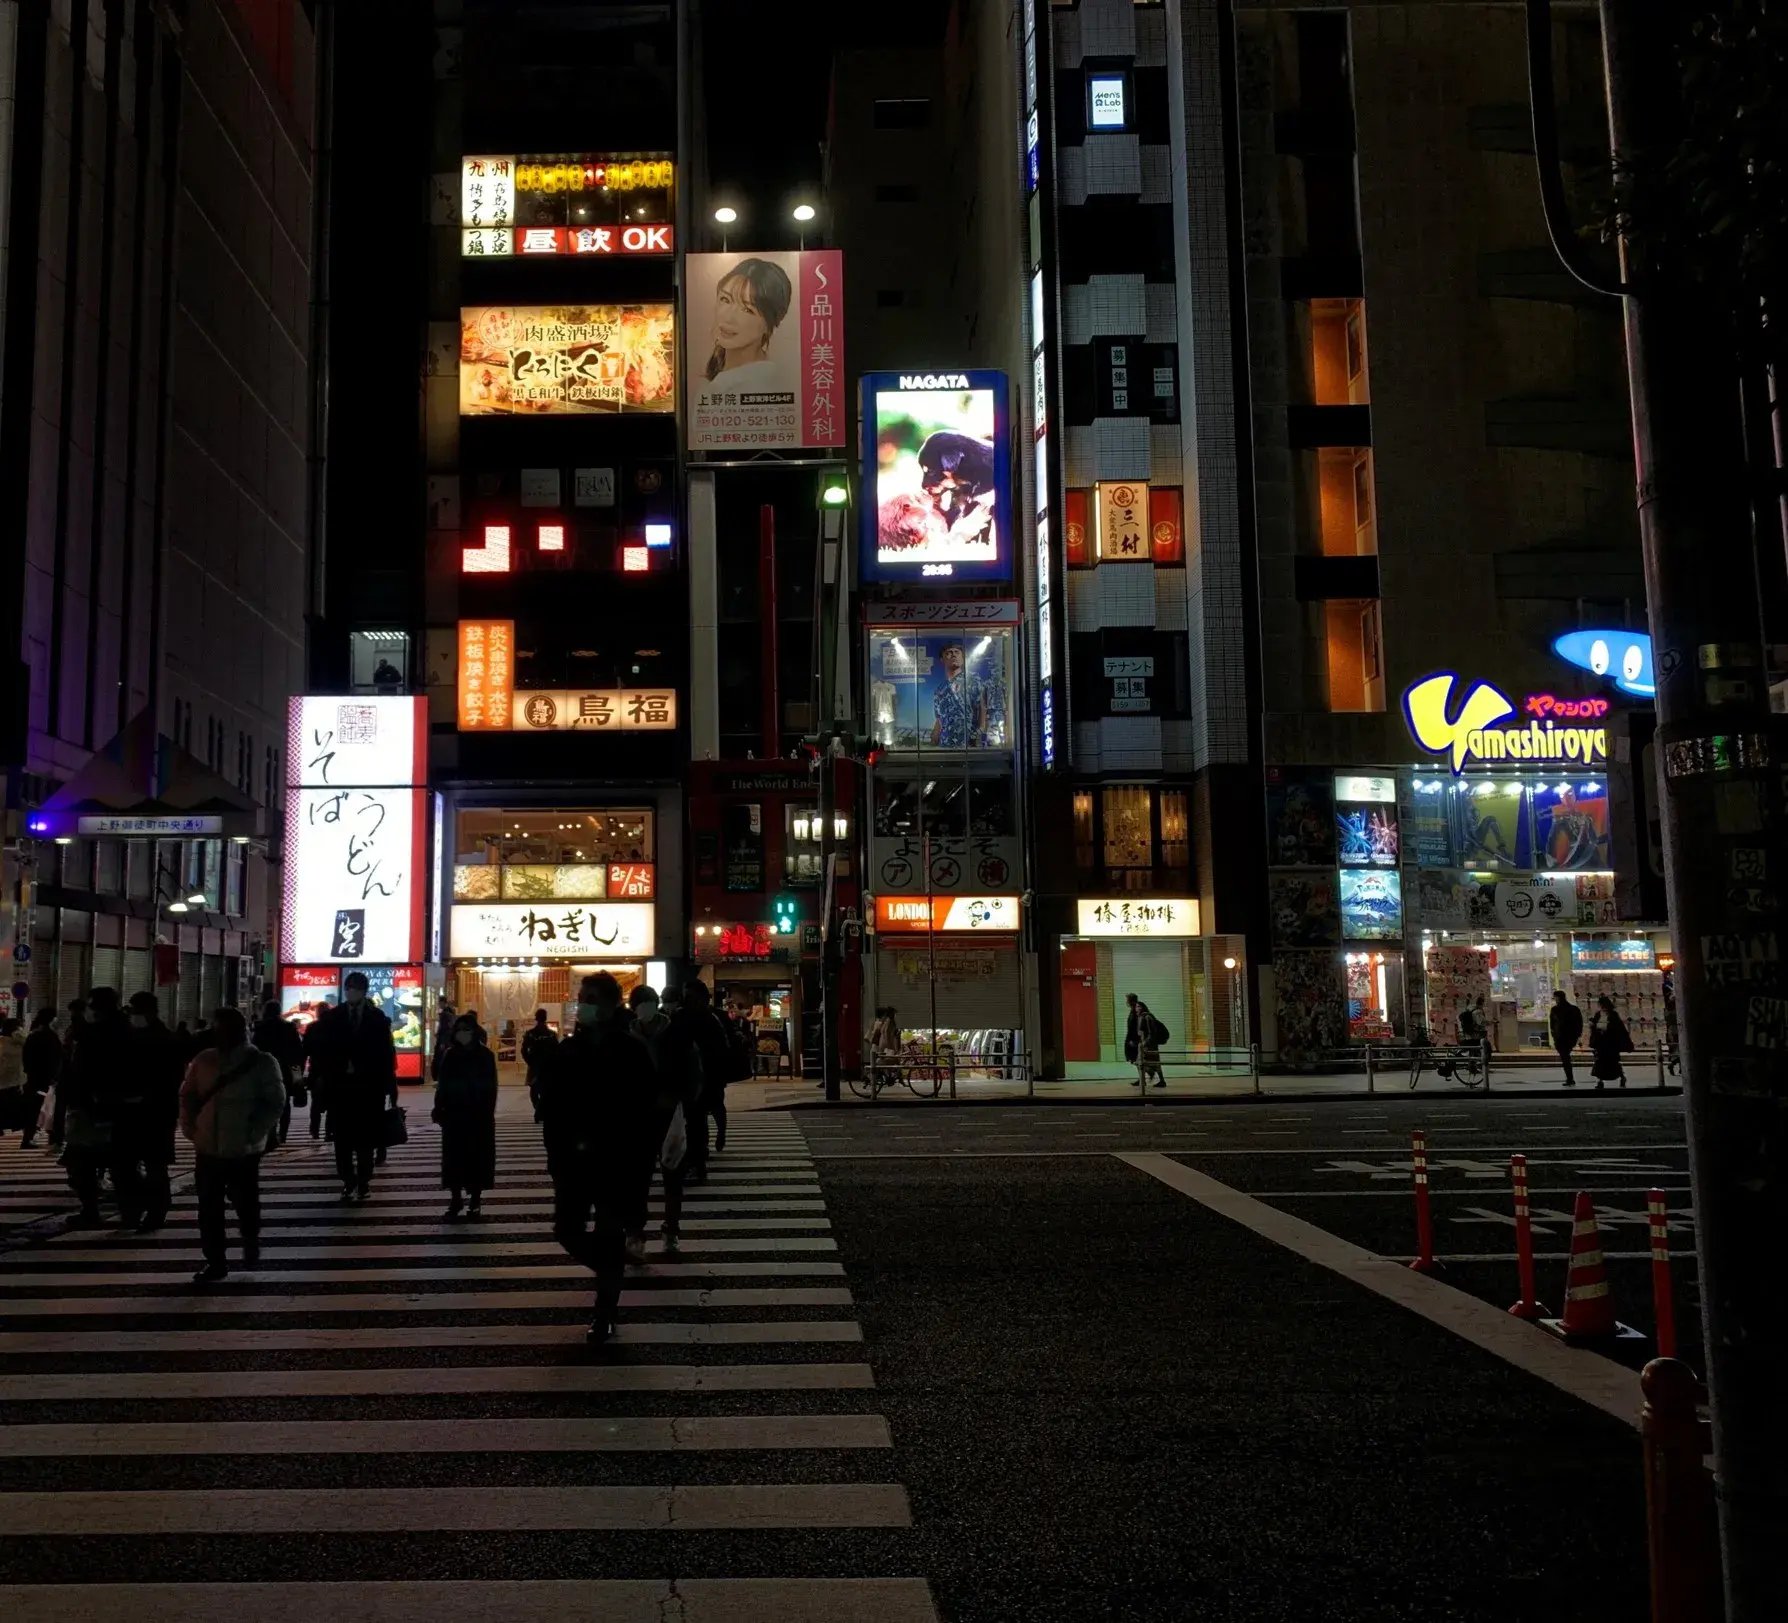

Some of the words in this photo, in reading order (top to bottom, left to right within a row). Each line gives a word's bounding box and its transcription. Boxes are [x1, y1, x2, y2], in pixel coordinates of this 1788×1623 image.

[469, 161, 509, 177] 九州
[467, 183, 485, 254] 博多もつ鍋
[525, 325, 611, 342] 肉盛酒場
[810, 294, 835, 441] 品川美容外科
[1113, 349, 1126, 405] 募集中
[899, 374, 969, 389] NAGATA
[697, 393, 737, 406] 上野院
[711, 415, 795, 427] 0120-521-130
[697, 433, 795, 443] JR上野駅より徒歩5分
[882, 605, 1003, 620] スポーツジュエン
[465, 626, 484, 727] 鉄板焼き餃子
[1106, 661, 1151, 672] テナント
[571, 695, 670, 729] 鳥福
[1527, 695, 1609, 718] ヤマシロヤ
[1408, 674, 1606, 772] Yamashiroya
[97, 819, 204, 831] 上野御徒町中央通り
[345, 793, 402, 900] うどん
[894, 837, 999, 857] ようこそ
[888, 902, 935, 921] LONDON
[1093, 901, 1176, 924] 椿屋珈琲
[518, 908, 619, 946] ねぎし
